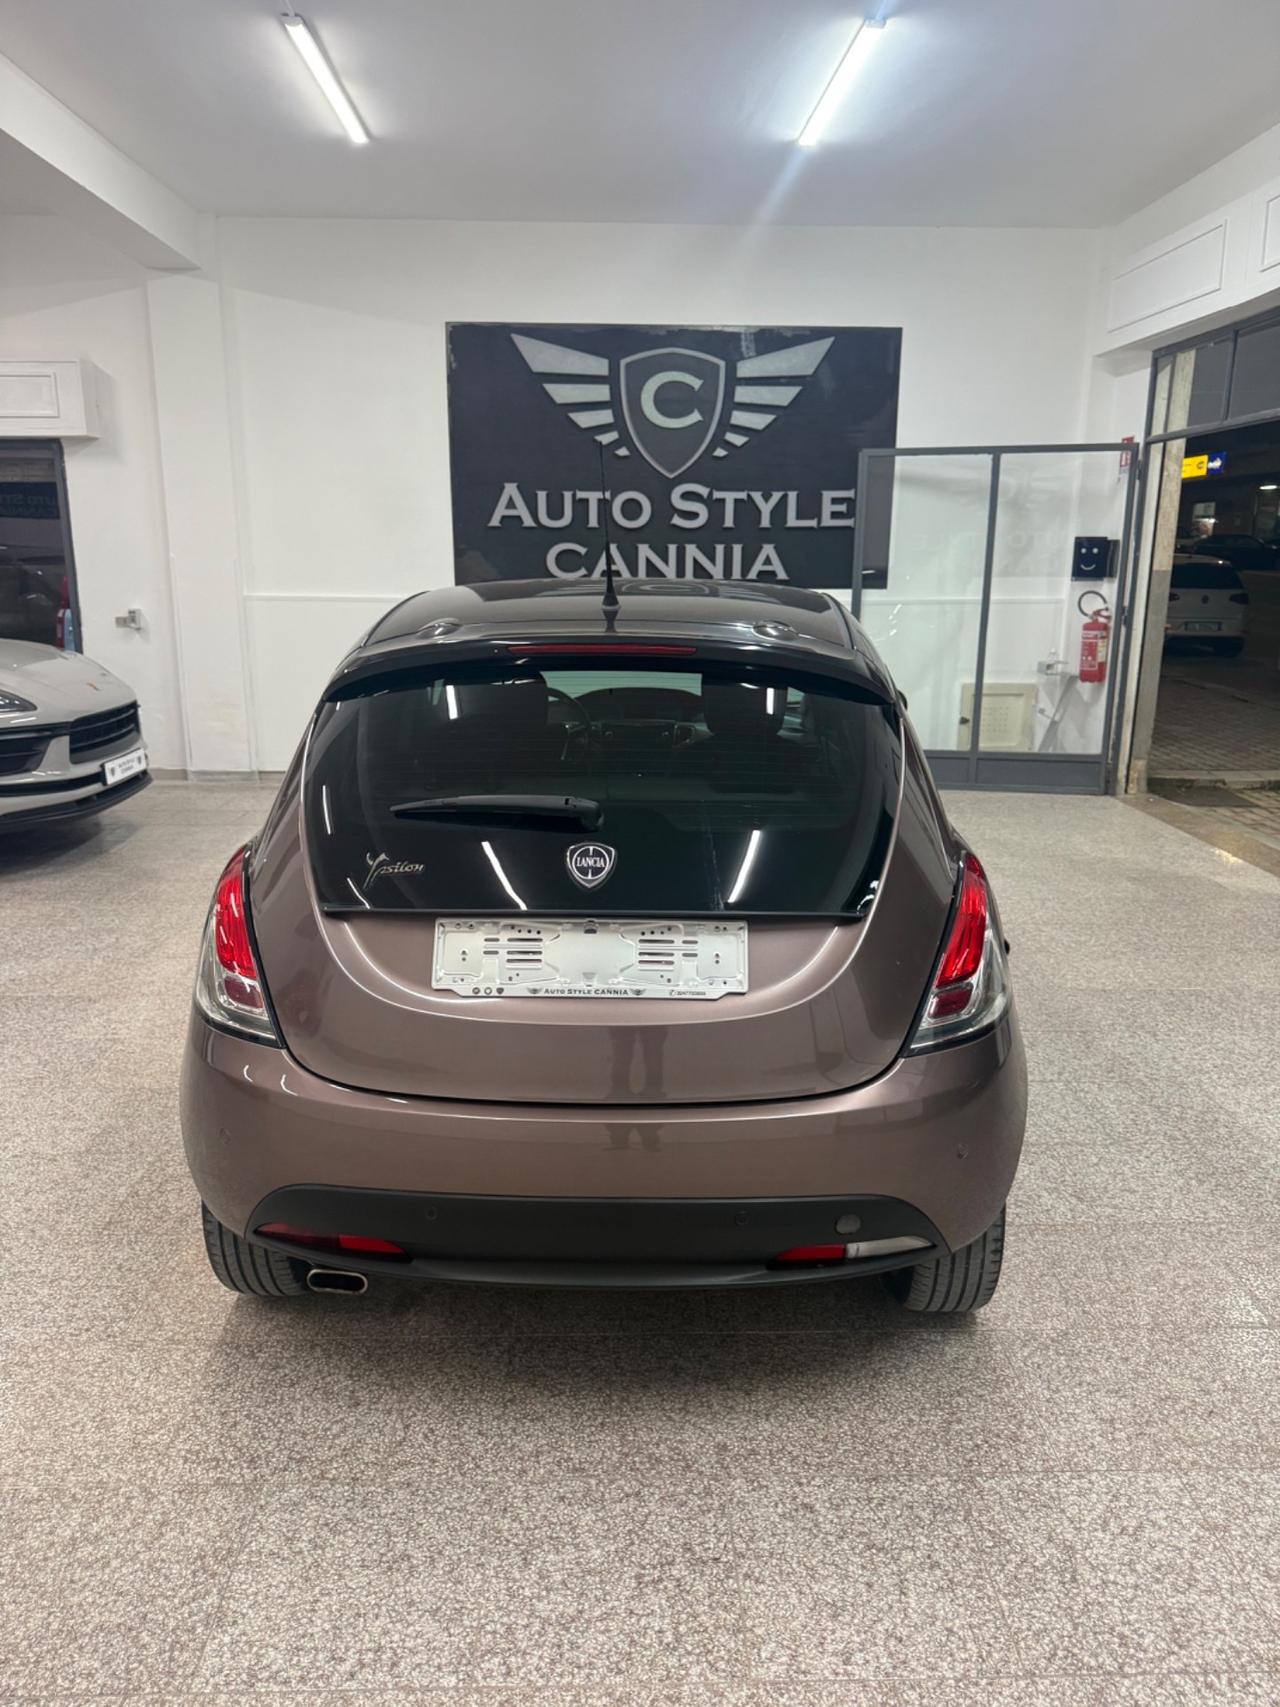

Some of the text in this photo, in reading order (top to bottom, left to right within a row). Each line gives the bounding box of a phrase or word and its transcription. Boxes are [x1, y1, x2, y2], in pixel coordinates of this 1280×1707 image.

[640, 371, 704, 428] C
[487, 483, 855, 529] AUTO STYLE
[545, 542, 789, 580] CANNIA
[362, 851, 425, 890] Ypsilon
[576, 857, 606, 869] LANCIA
